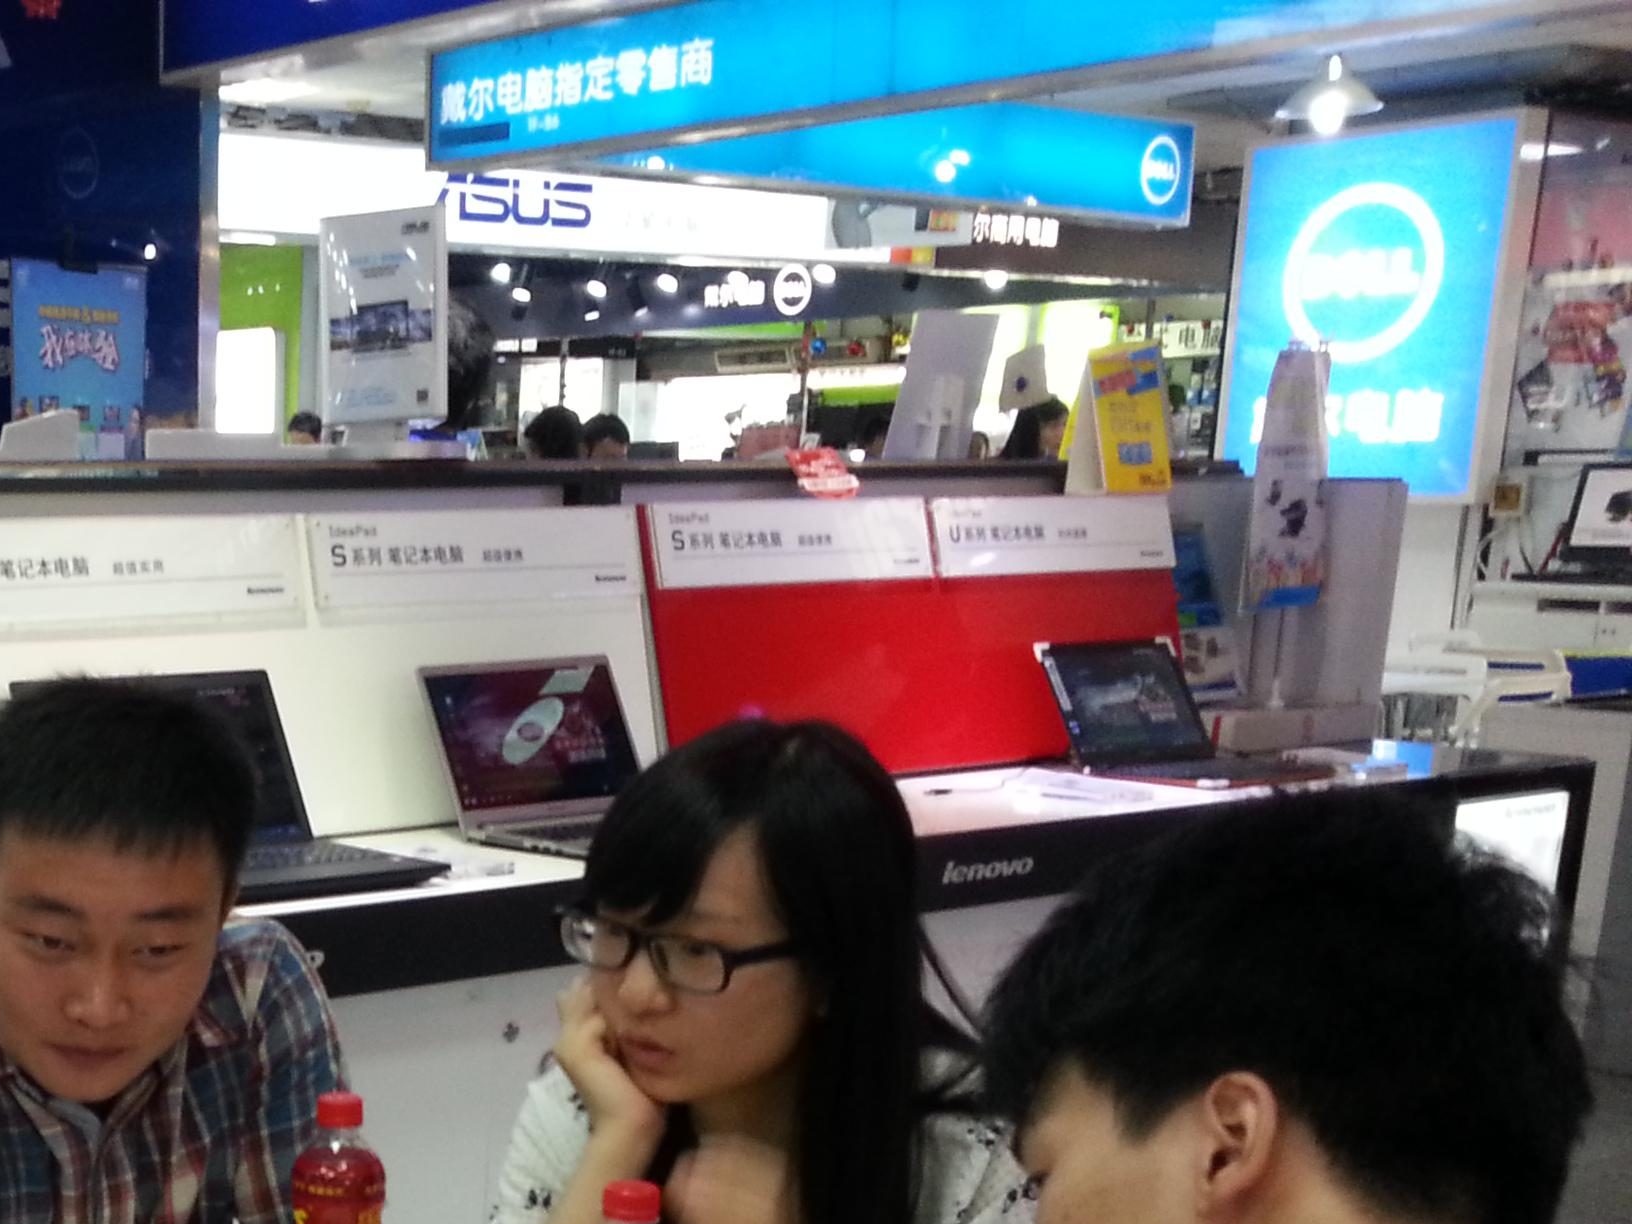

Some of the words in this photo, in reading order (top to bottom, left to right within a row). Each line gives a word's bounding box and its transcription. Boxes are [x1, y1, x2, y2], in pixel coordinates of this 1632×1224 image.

[440, 38, 715, 125] 戴尔电脑指定零售商
[942, 857, 1035, 885] lenovo
